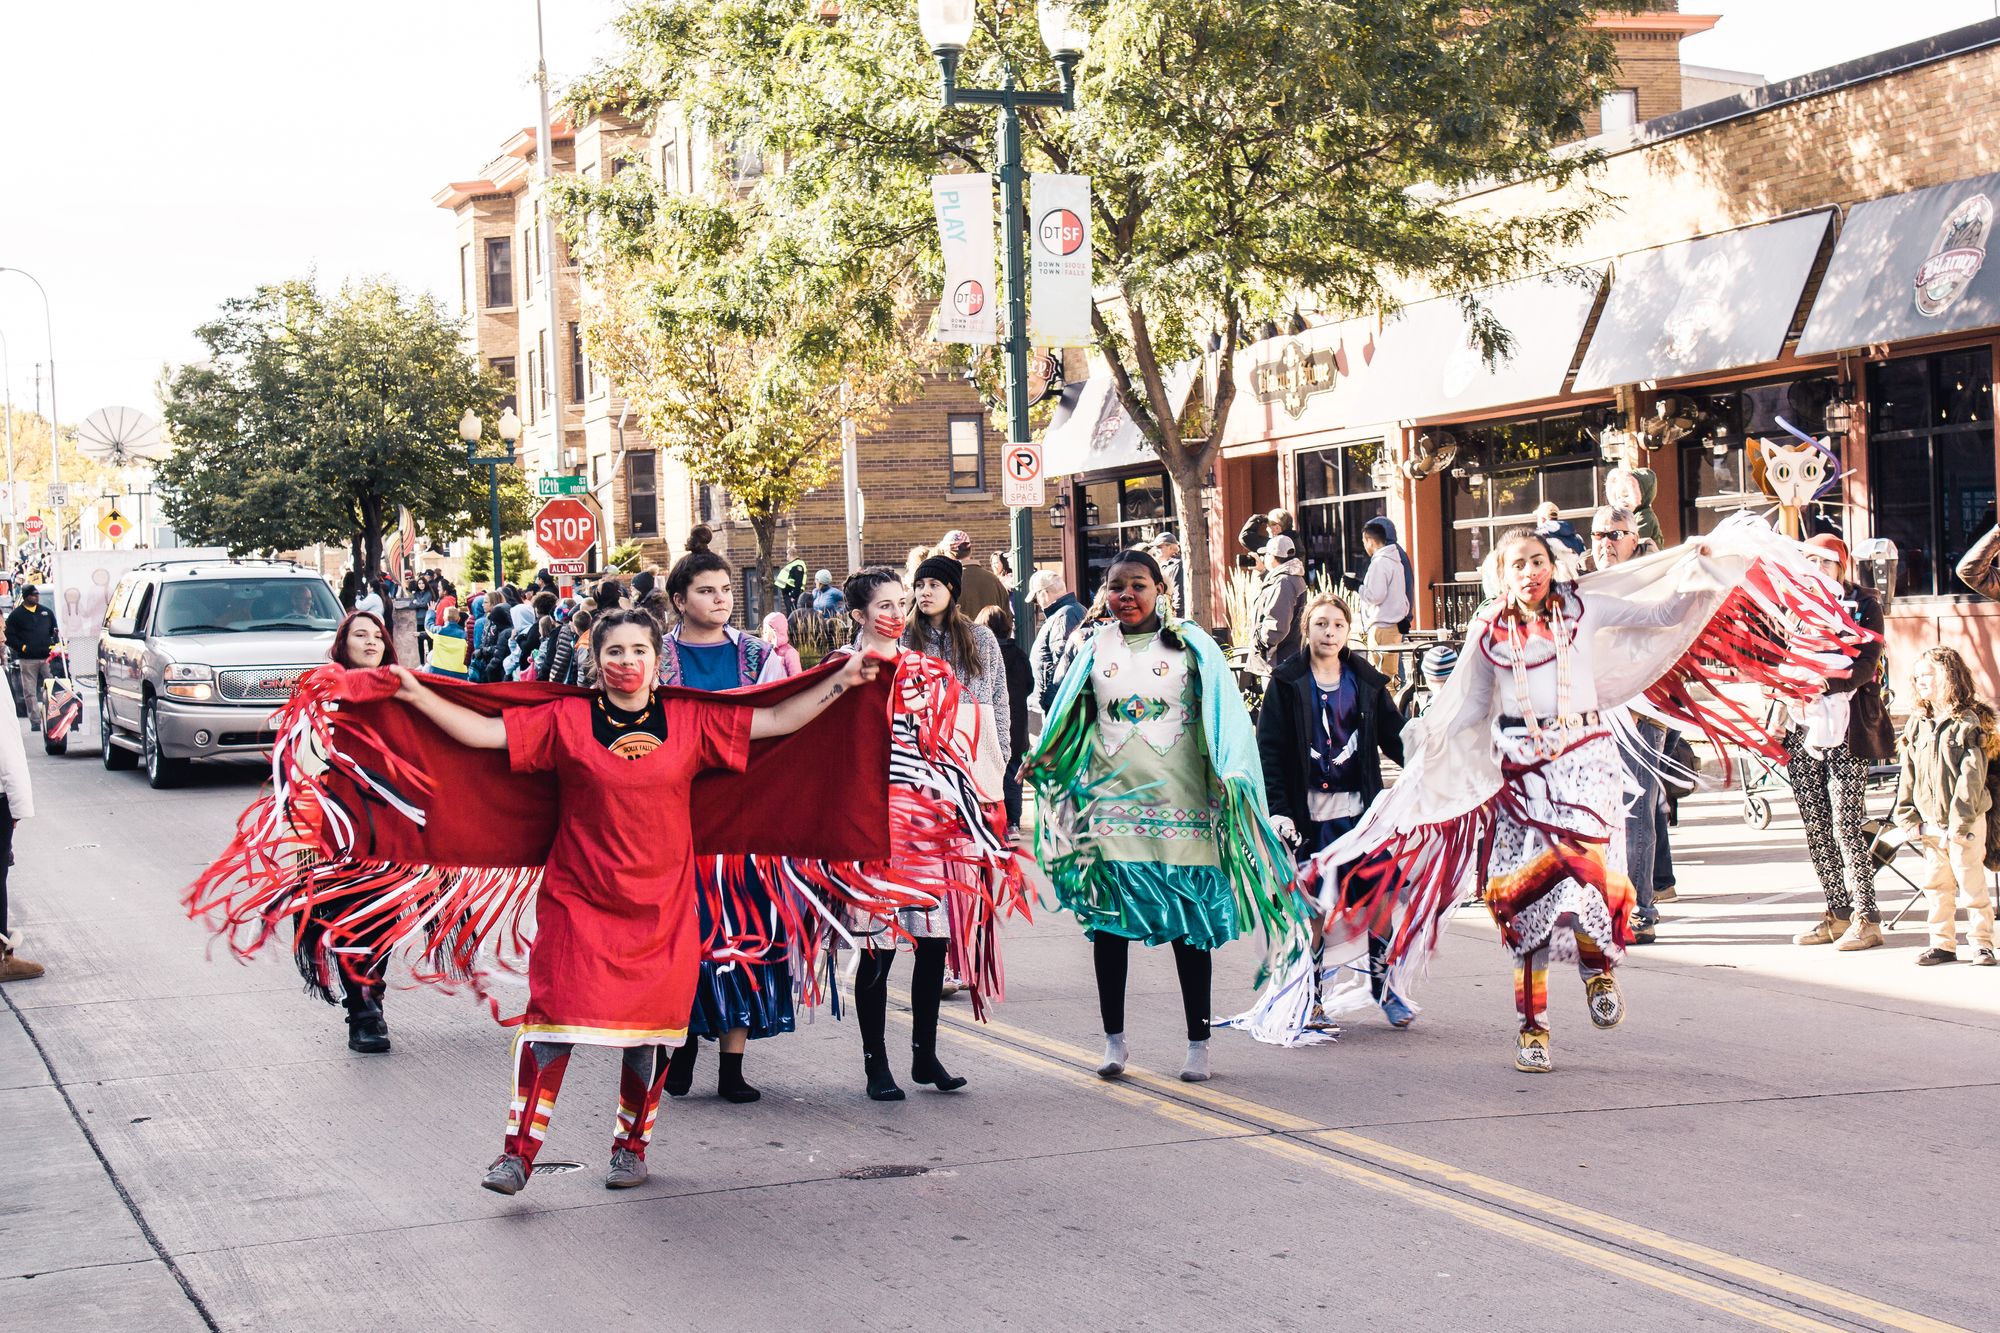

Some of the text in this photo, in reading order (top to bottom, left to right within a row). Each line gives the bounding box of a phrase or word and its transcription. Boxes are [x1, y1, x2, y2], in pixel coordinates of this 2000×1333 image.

[940, 191, 966, 243] PLAY
[1044, 226, 1080, 241] DTSF
[957, 293, 983, 305] DTSF
[541, 479, 559, 493] 12th
[1015, 483, 1034, 492] THIS
[52, 495, 65, 505] 15
[1010, 493, 1038, 502] SPACE
[26, 520, 43, 529] STOP
[539, 518, 591, 542] STOP
[551, 564, 583, 573] ALL WAY
